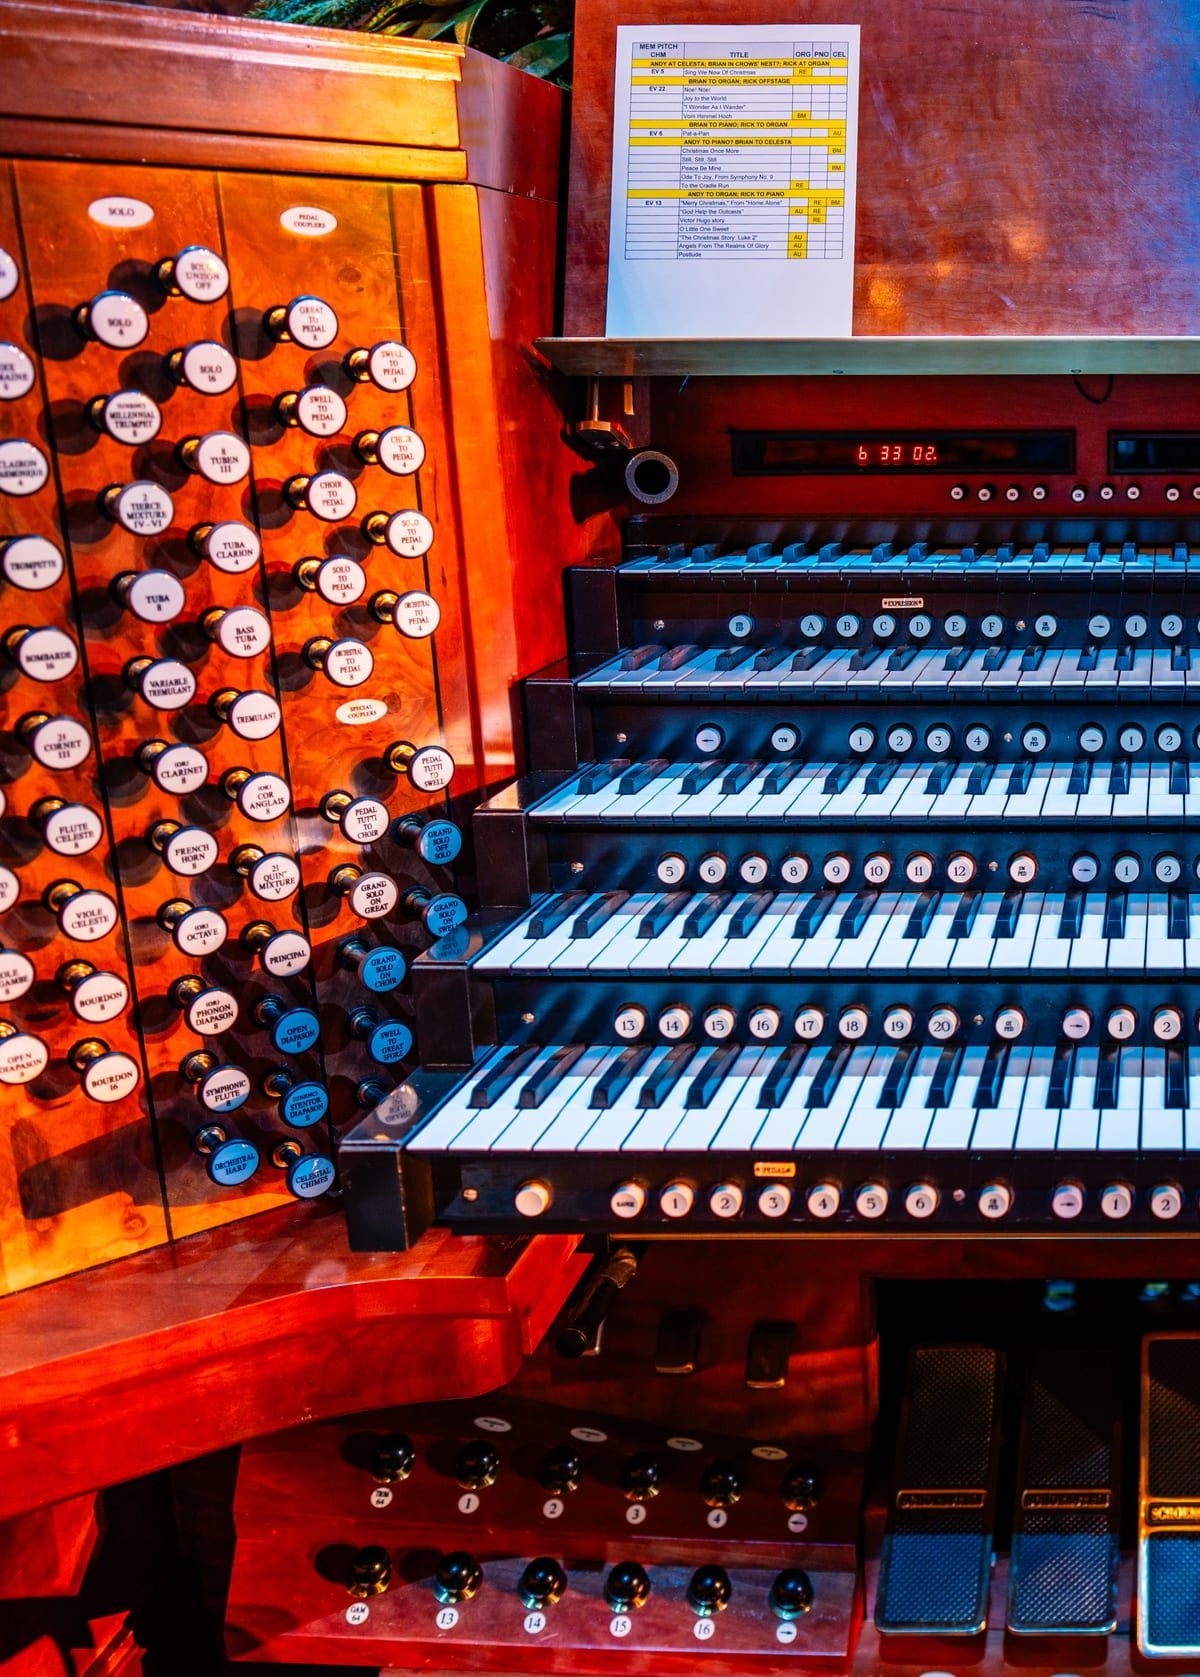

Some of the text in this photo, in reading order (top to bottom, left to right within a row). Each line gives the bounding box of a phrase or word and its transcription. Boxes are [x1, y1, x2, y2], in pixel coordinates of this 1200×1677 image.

[108, 207, 135, 217] SOLO
[381, 350, 404, 360] SWELL
[199, 365, 223, 374] SOLO
[383, 367, 406, 377] PEDAL
[207, 374, 216, 382] 16
[392, 376, 398, 384] 4
[881, 446, 901, 460] 33
[222, 541, 246, 551] TUBA
[216, 548, 254, 559] CLARION
[233, 558, 239, 566] 4
[234, 627, 255, 635] BASS
[808, 622, 815, 631] A
[844, 622, 851, 631] B
[880, 622, 887, 631] C
[916, 622, 923, 631] D
[952, 622, 958, 631] E
[989, 622, 996, 631] F
[234, 634, 258, 643] TUBA
[243, 643, 252, 651] 16
[149, 678, 190, 689] VARIABLE
[148, 686, 192, 697] TREMULANT
[160, 764, 204, 779] CLARINET
[181, 777, 187, 785] 8
[175, 843, 210, 857] FRENCH
[181, 853, 206, 863] HORN
[191, 862, 197, 870] 8
[831, 866, 840, 877] 9
[870, 866, 883, 877] 10
[913, 866, 924, 877] 11
[953, 866, 966, 877] 12
[360, 881, 387, 892] GRAND
[366, 889, 384, 899] SOLO
[369, 897, 381, 905] ON
[364, 903, 389, 914] GREAT
[270, 950, 307, 965] PRINCIPAL
[286, 961, 292, 969] 4
[196, 1005, 231, 1018] PHONON
[195, 1013, 234, 1026] DIAPASON
[206, 1081, 247, 1096] SYMPHONIC
[214, 1089, 241, 1101] FLUTE
[214, 1156, 255, 1171] ORCHESTRAL
[225, 1164, 247, 1174] HARP
[295, 1170, 331, 1185] CELESTIAL
[300, 1178, 329, 1189] CHIMES
[441, 1613, 454, 1624] 13
[528, 1616, 541, 1628] 14
[614, 1620, 626, 1632] 15
[698, 1623, 710, 1635] 16
